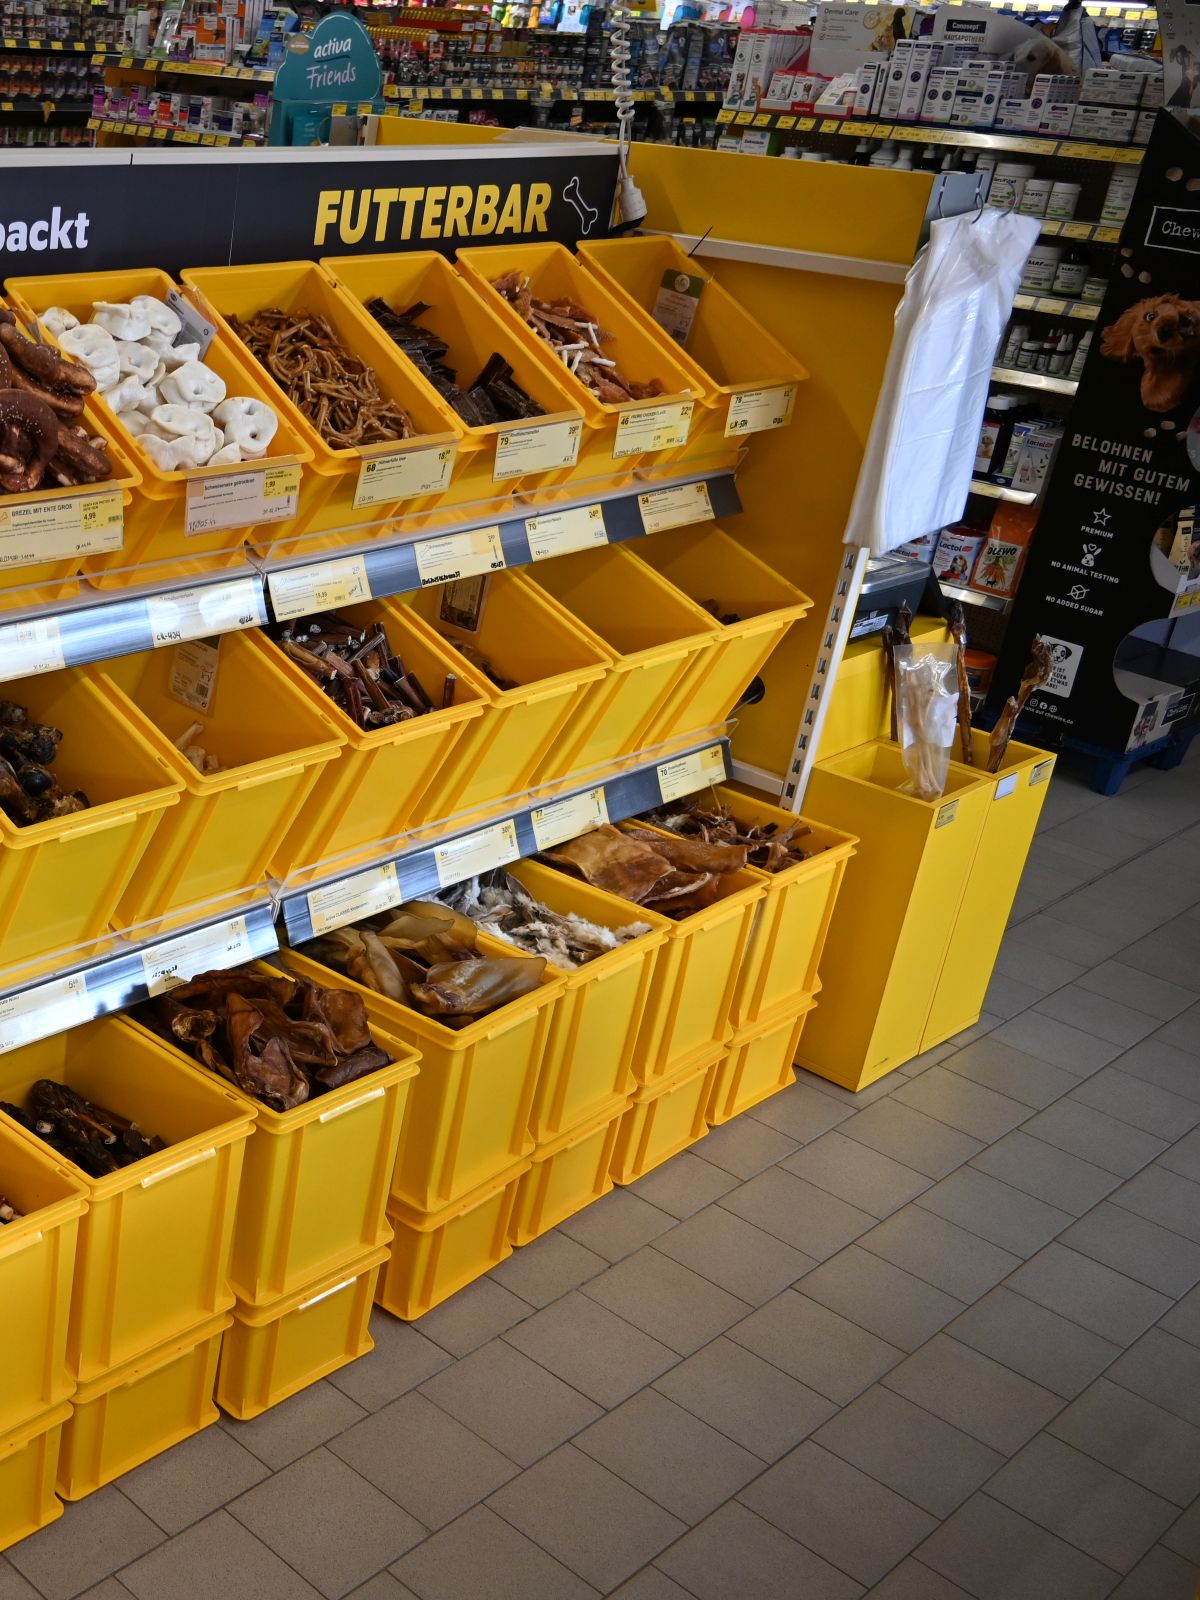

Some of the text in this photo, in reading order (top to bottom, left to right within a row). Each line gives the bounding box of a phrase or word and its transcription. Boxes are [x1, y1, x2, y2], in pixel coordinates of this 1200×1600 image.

[314, 37, 352, 59] activa
[306, 62, 356, 90] Friends
[315, 182, 553, 246] FUTTERBAR
[500, 437, 509, 446] 79
[1072, 434, 1153, 463] BELOHNEN
[1099, 459, 1190, 492] MIT GUTEM
[1074, 473, 1162, 505] GEWISSEN!
[11, 509, 32, 517] BREZEL
[43, 505, 57, 513] ENTE
[1080, 526, 1114, 539] PREMIUM
[939, 540, 962, 552] Lactol
[987, 547, 1017, 557] OLEWO
[1062, 564, 1088, 576] ANIMAL
[1090, 571, 1120, 584] TESTING
[1045, 595, 1104, 617] NO ADDED SUGAR
